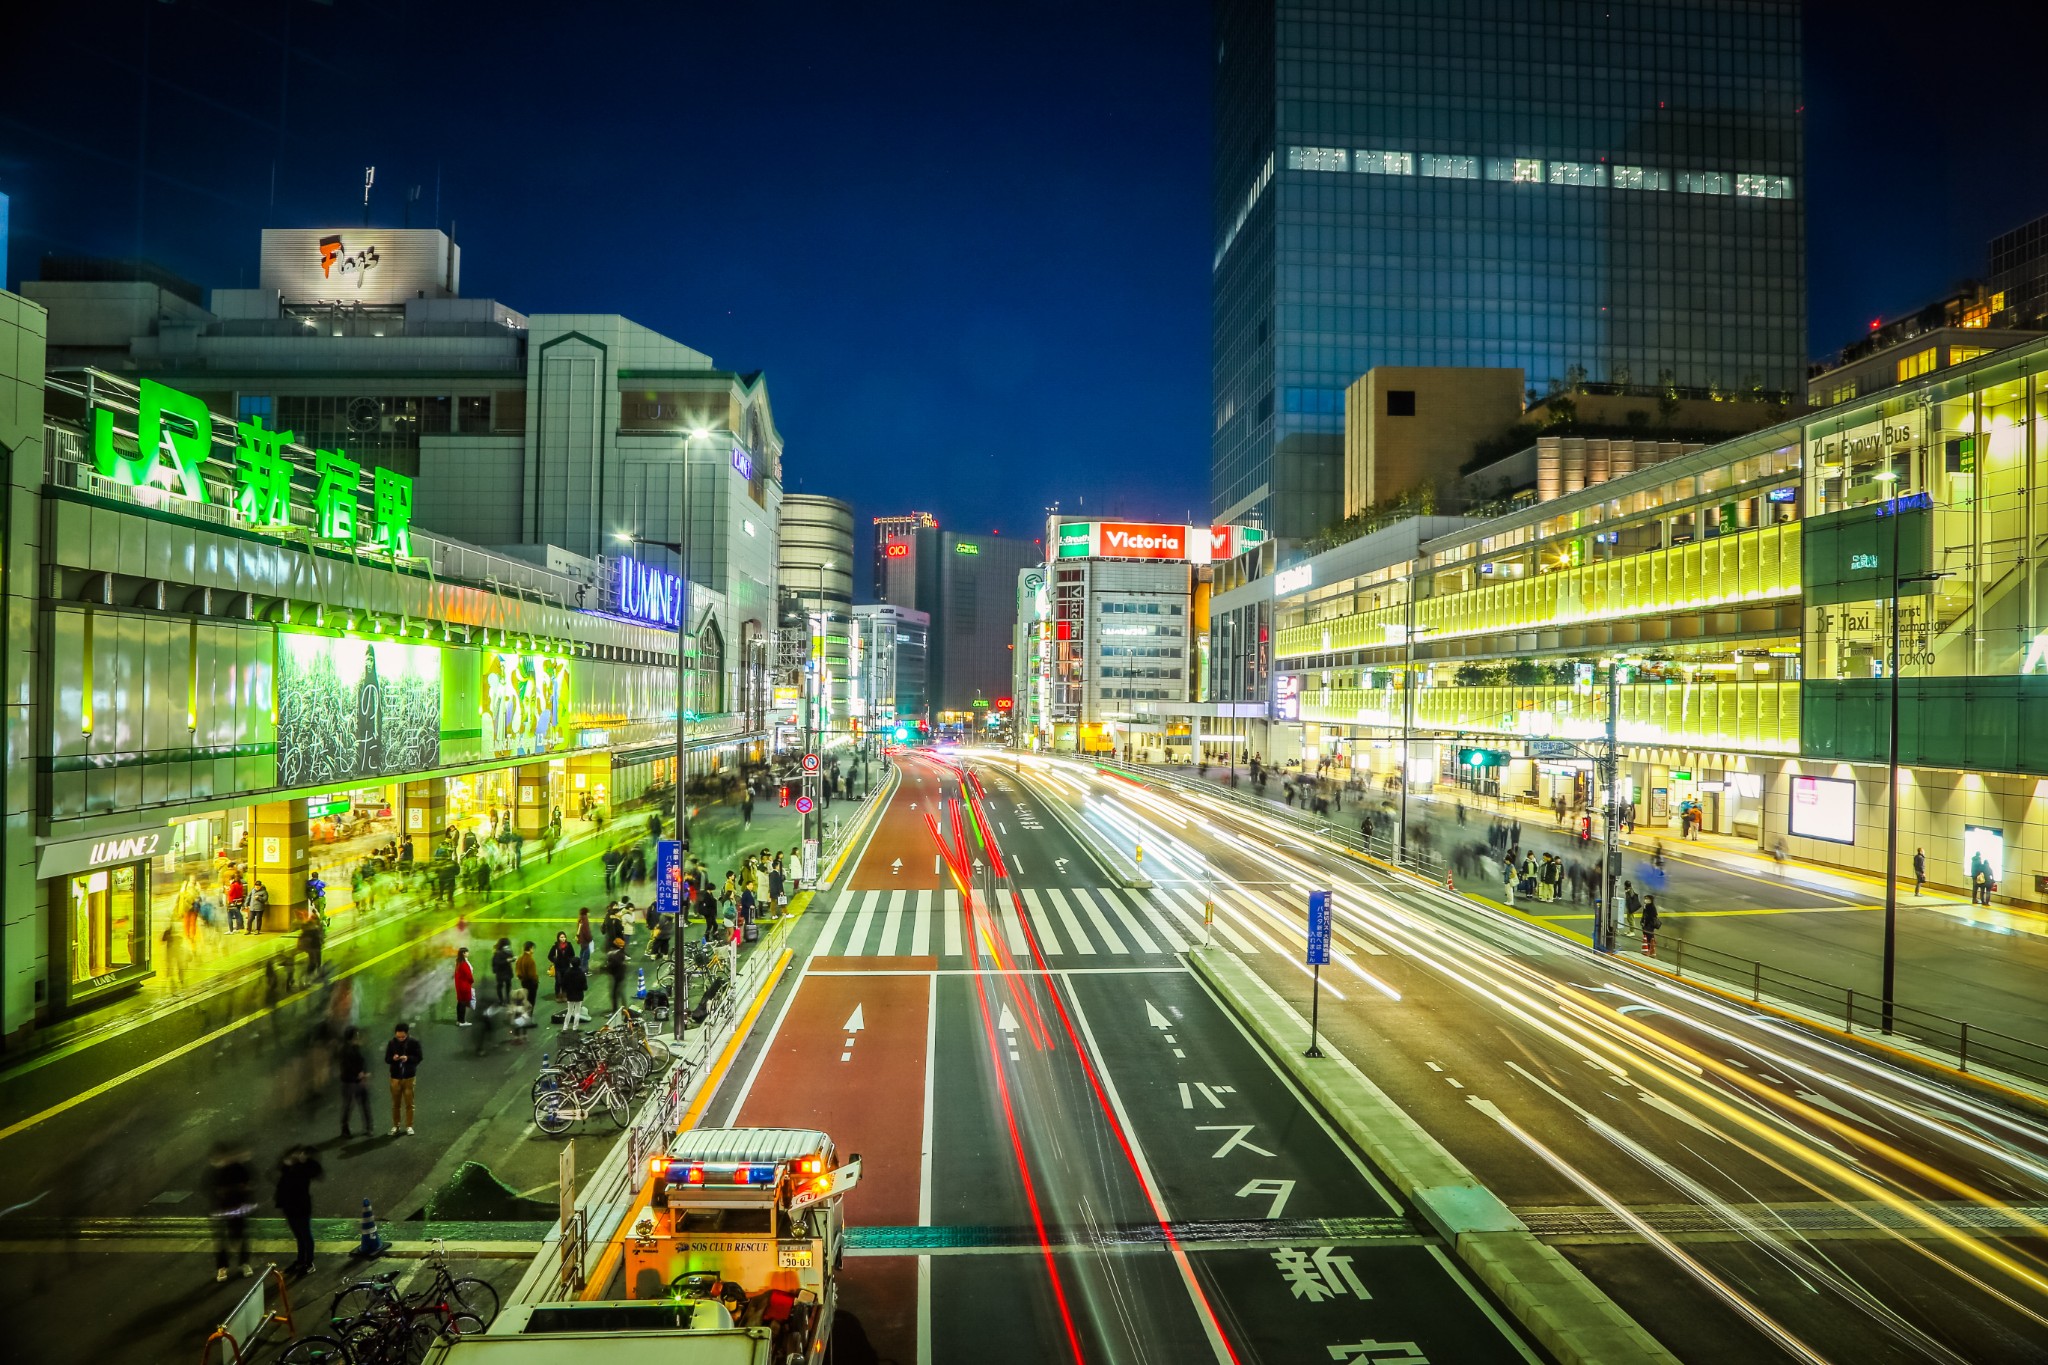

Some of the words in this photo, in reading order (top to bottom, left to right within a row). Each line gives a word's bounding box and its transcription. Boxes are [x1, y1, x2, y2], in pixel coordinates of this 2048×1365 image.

[319, 235, 380, 288] Flags
[1885, 425, 1910, 445] Bus
[95, 379, 211, 504] JR
[234, 414, 413, 558] 新宿駅
[1106, 530, 1179, 550] Victoria
[620, 555, 673, 624] LUMINE
[674, 577, 681, 627] 2
[1815, 606, 1835, 633] 3F
[1840, 611, 1870, 632] Taxi
[1887, 604, 1921, 619] Turist
[1887, 619, 1948, 634] Iormation
[1887, 634, 1921, 649] Cnter
[89, 835, 149, 865] LUMINE
[145, 833, 160, 854] 2
[658, 879, 666, 911] 入れません
[1308, 931, 1316, 963] 入れません
[92, 973, 117, 988] LUMINE
[690, 1242, 709, 1252] SOS
[709, 1242, 734, 1252] CLUB
[734, 1242, 770, 1252] RESCUE
